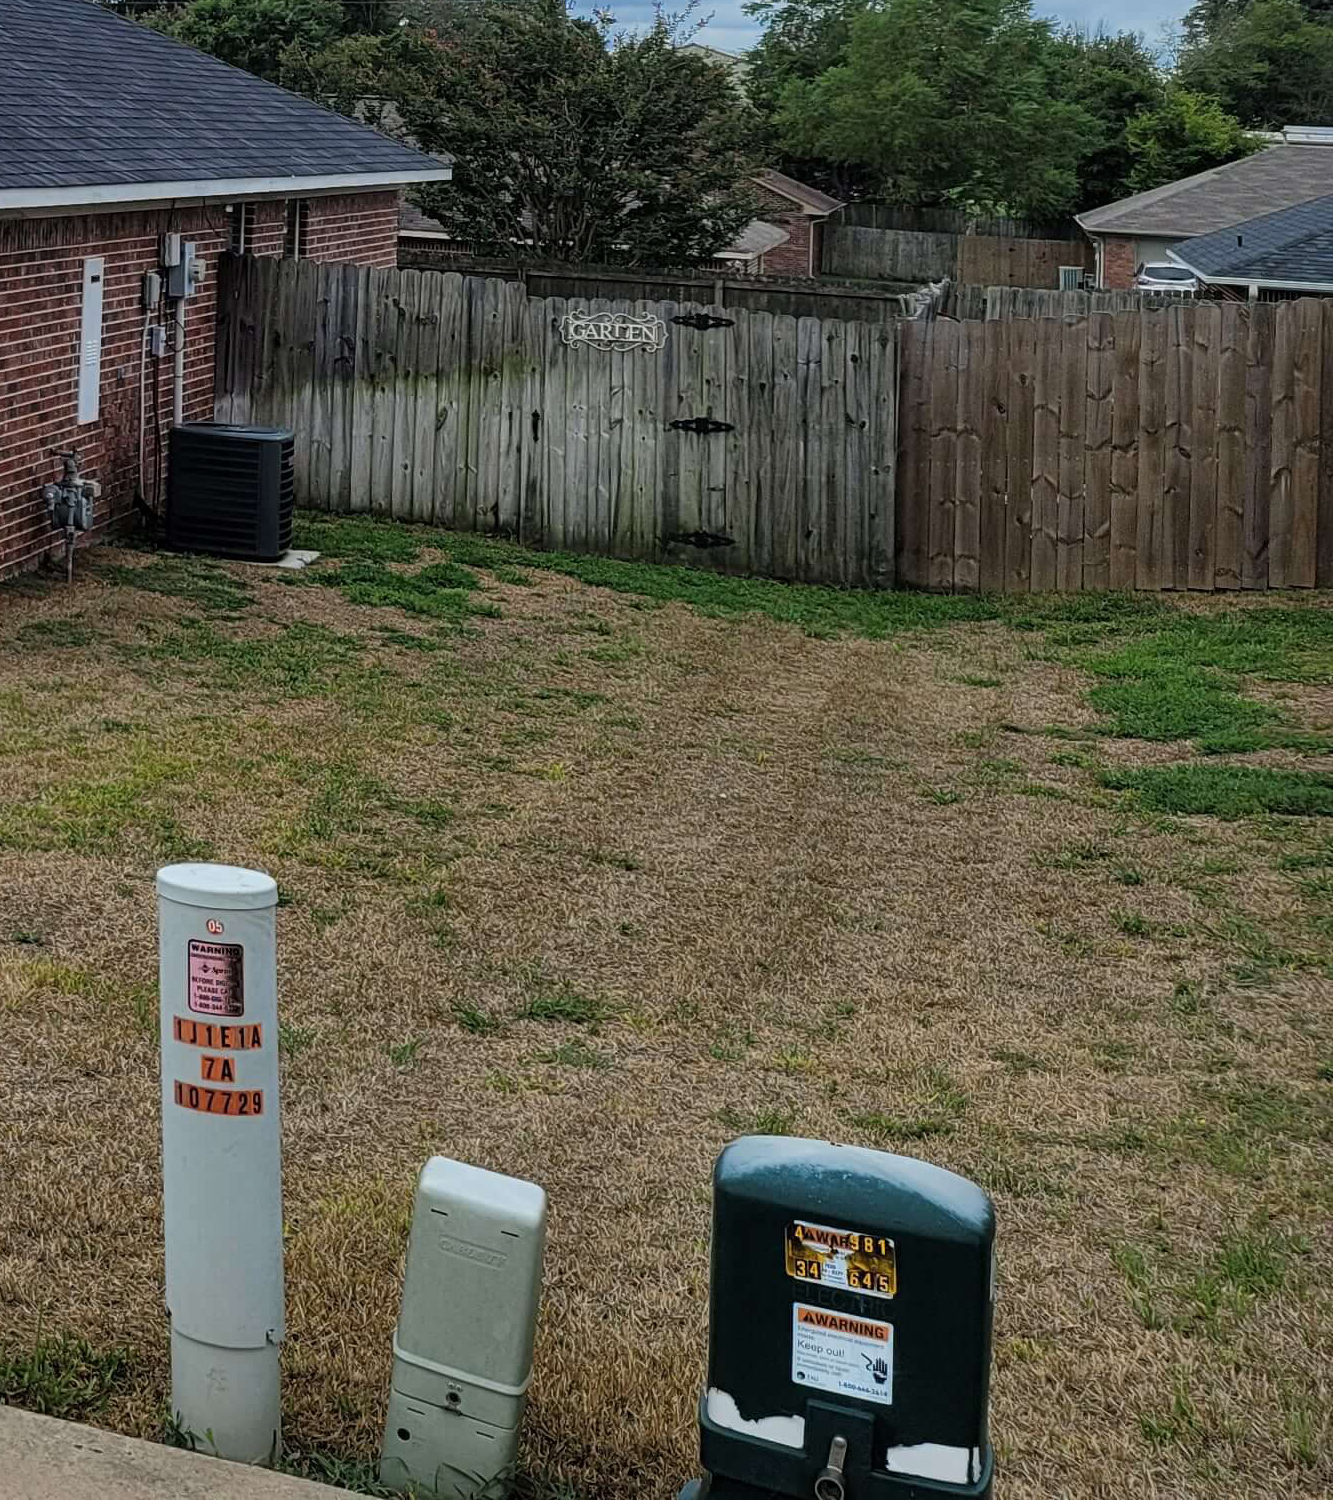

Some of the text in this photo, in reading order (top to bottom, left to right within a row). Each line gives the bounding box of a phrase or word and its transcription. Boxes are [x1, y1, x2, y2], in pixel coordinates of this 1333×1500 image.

[208, 919, 223, 933] 05
[191, 943, 240, 957] WARNING
[196, 985, 219, 996] PLEASE
[203, 1057, 235, 1082] 7A
[178, 1082, 263, 1115] 107729
[814, 1311, 885, 1340] WARNING
[797, 1339, 824, 1354] Keep
